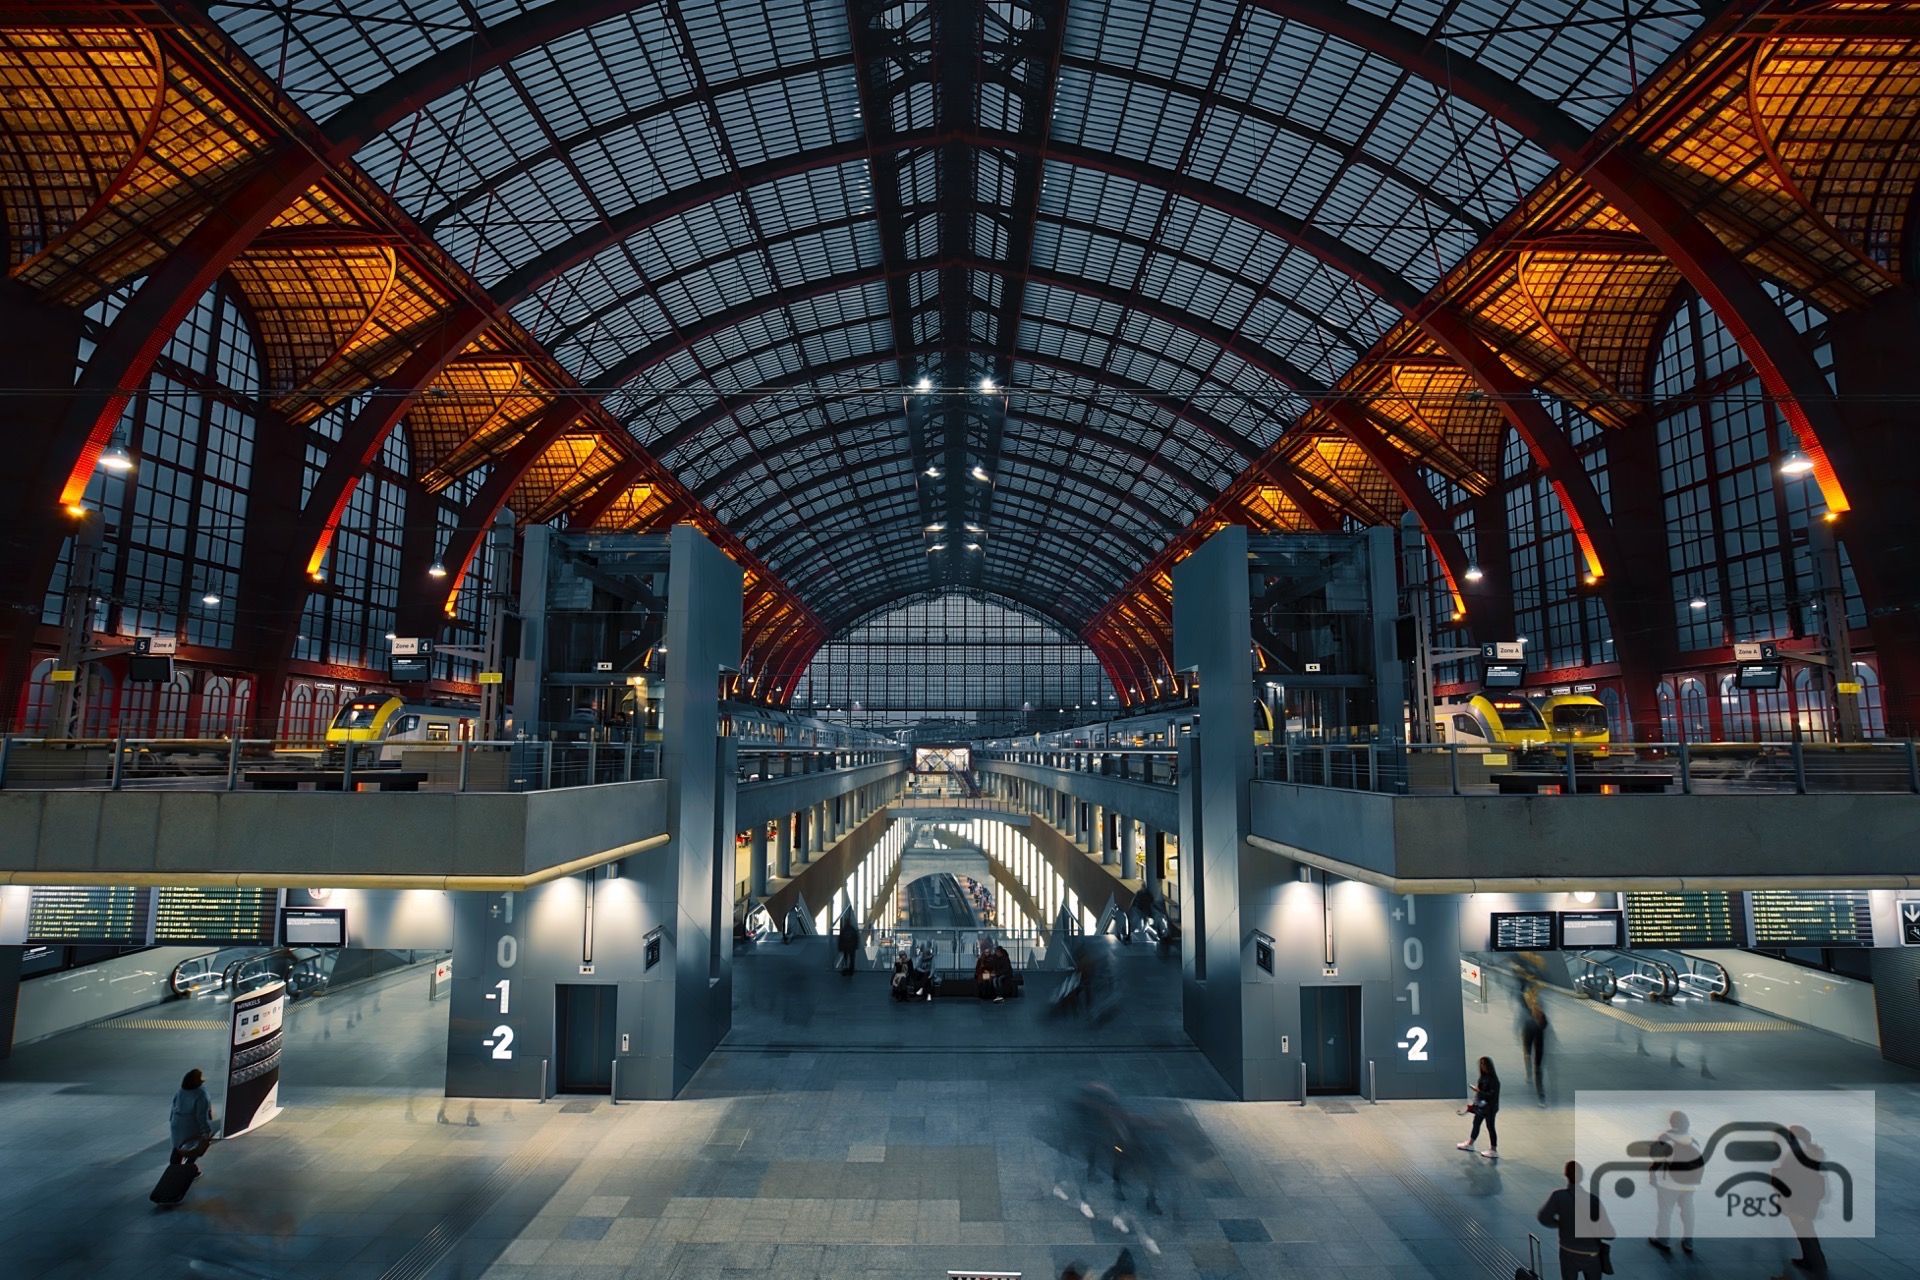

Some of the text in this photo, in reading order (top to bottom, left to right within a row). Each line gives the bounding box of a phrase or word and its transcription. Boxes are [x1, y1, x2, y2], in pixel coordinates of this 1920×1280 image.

[140, 642, 145, 650] 5
[422, 642, 428, 650] 4
[1486, 647, 1493, 656] 3
[1766, 648, 1772, 656] 2
[490, 892, 514, 924] +1
[1392, 894, 1416, 925] +1
[497, 934, 517, 968] 0
[1403, 936, 1424, 970] 0
[237, 998, 260, 1009] WINKELS
[486, 980, 510, 1014] -1
[1396, 982, 1420, 1016] -1
[482, 1025, 514, 1060] -2
[1397, 1026, 1428, 1061] -2
